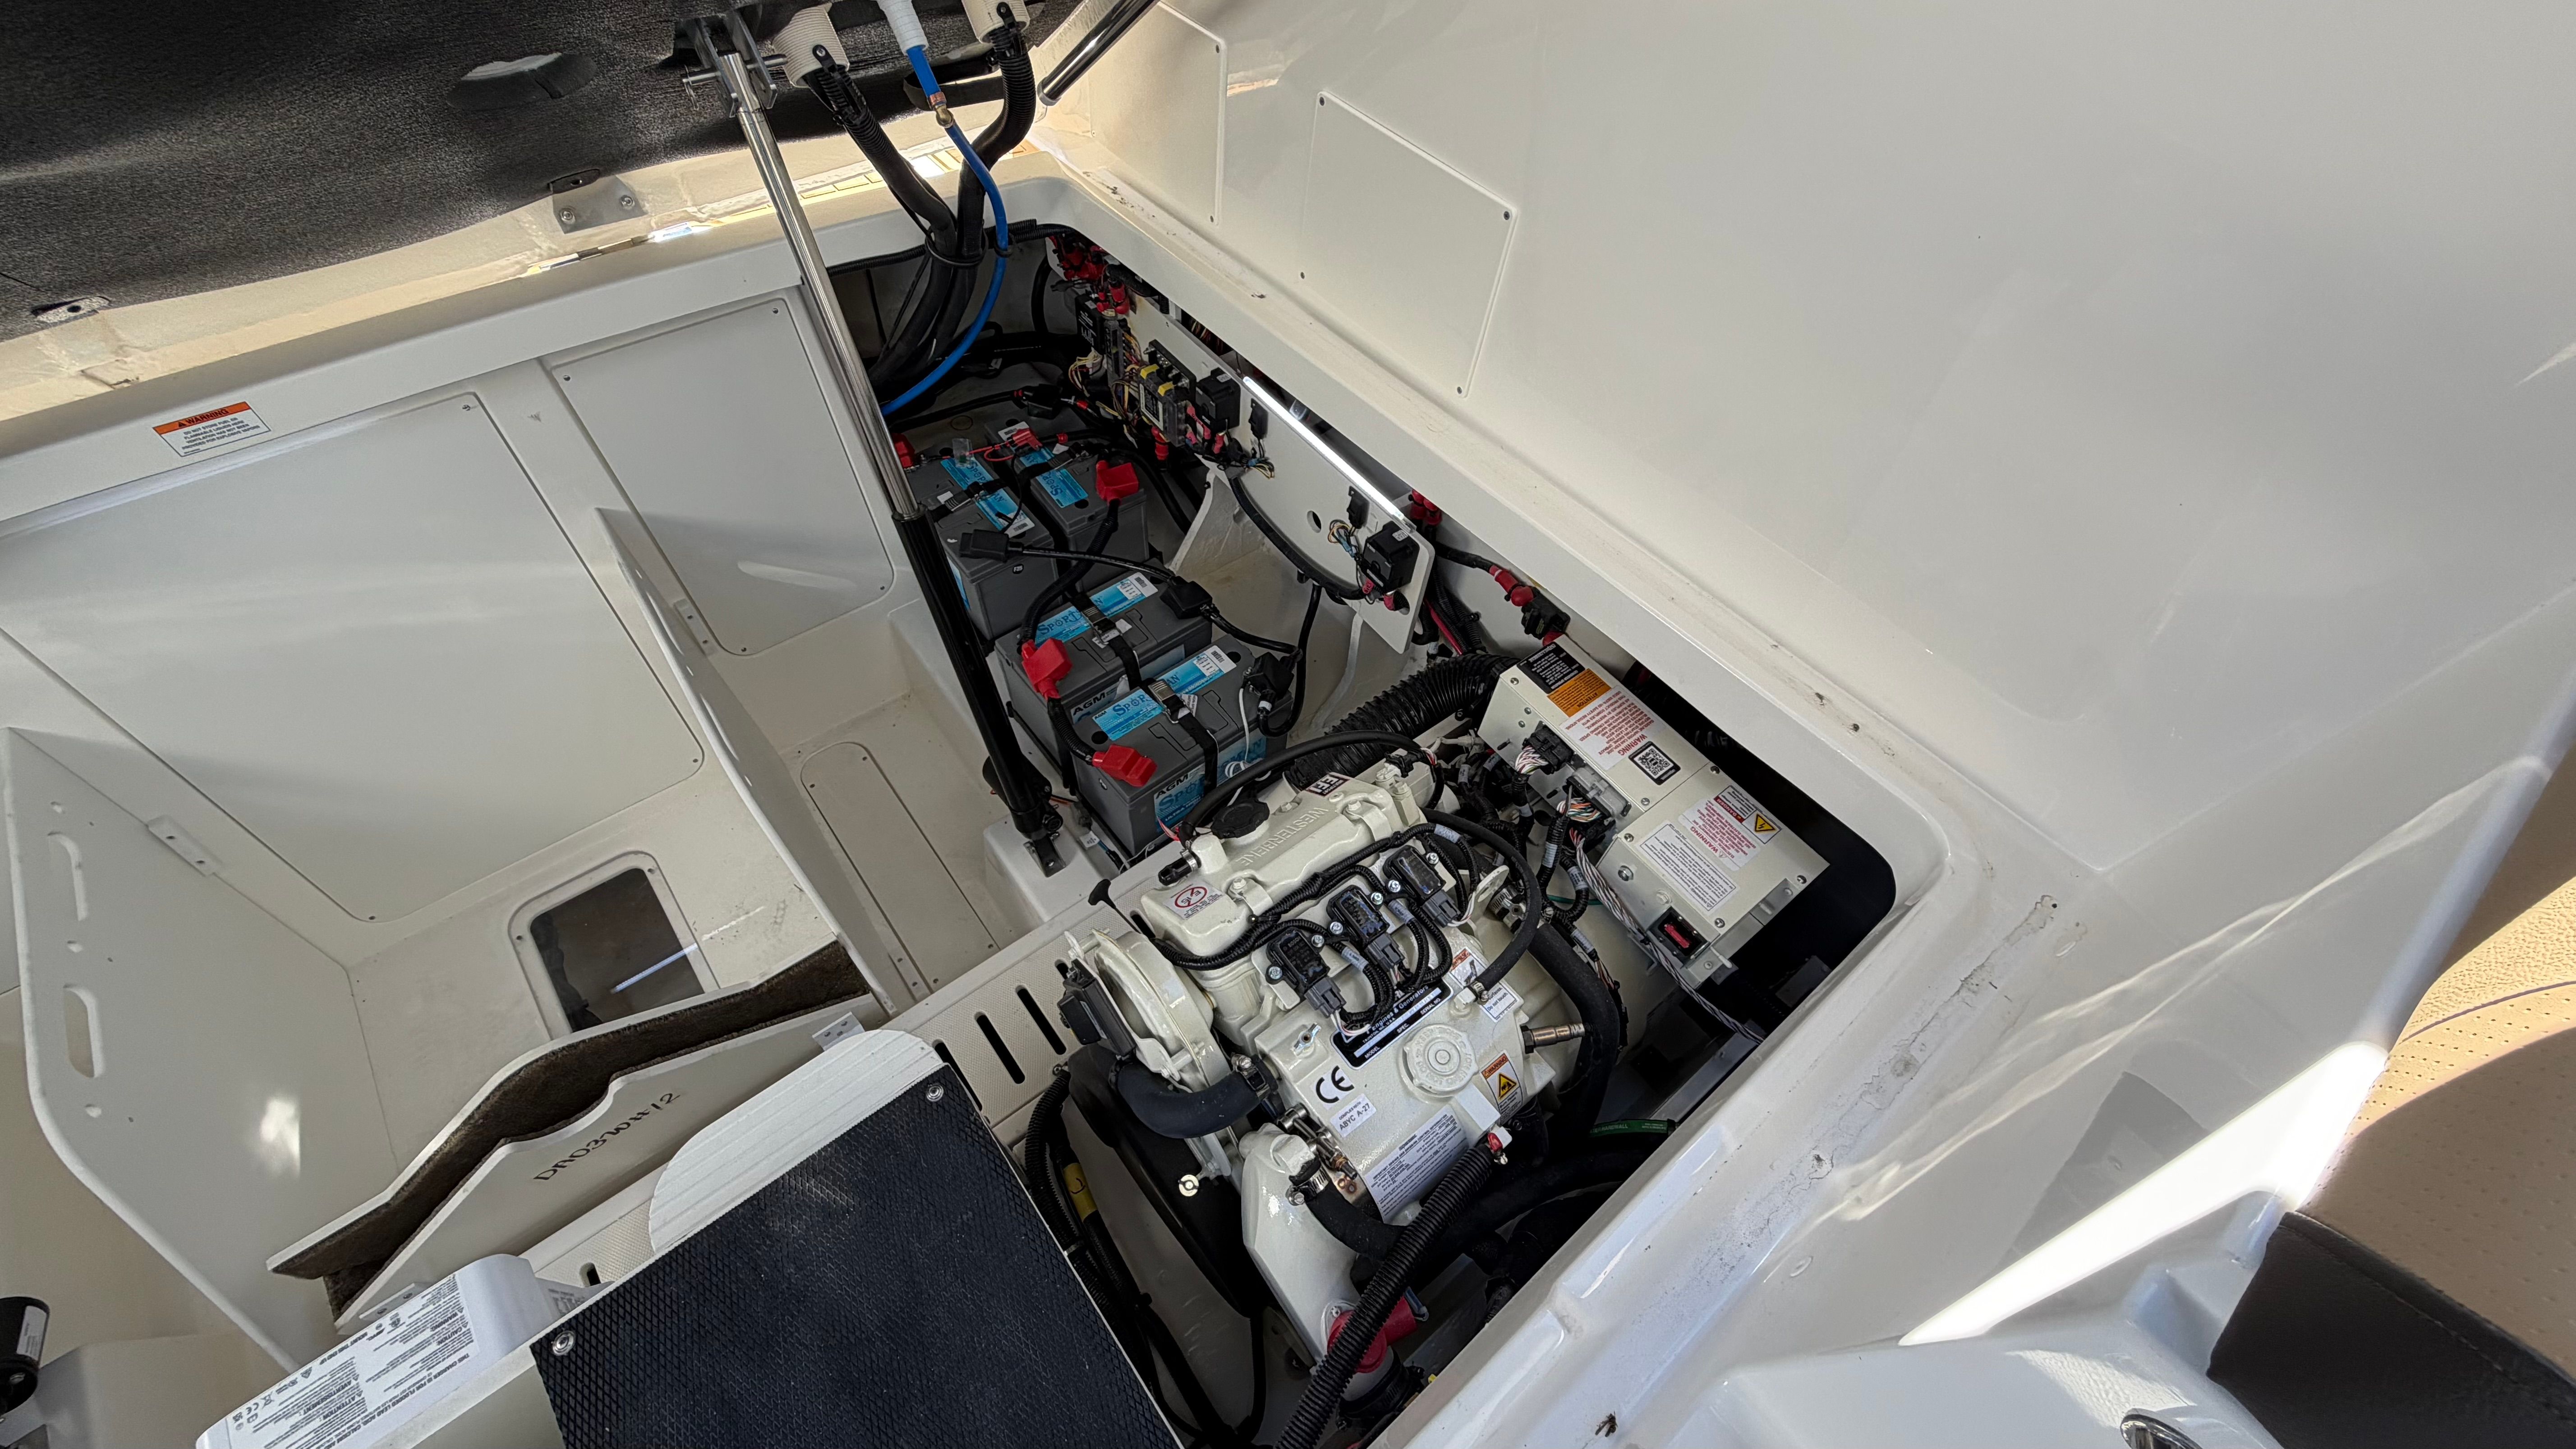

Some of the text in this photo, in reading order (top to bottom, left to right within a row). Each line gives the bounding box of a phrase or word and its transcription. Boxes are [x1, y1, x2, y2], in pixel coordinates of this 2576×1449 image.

[184, 408, 230, 425] WARNING
[1073, 692, 1105, 716] AGM
[1628, 708, 1641, 717] ENGINE
[1095, 710, 1107, 720] AGM
[1606, 715, 1631, 732] COMPARTMENT
[1633, 713, 1648, 724] BLOWER
[1637, 716, 1651, 726] BEFORE
[1613, 729, 1625, 738] LEAST
[1623, 724, 1639, 736] STARTING
[1638, 719, 1655, 731] GASOLINE
[1605, 736, 1615, 745] FOUR
[1626, 729, 1640, 740] VAPORS
[1597, 743, 1614, 755] OPERATE
[1615, 732, 1648, 756] WARNING
[1156, 772, 1189, 799] AGM
[1309, 775, 1339, 793] EFI
[1716, 798, 1738, 818] DANGER
[1235, 807, 1329, 866] WESTERBEKE
[1690, 826, 1719, 854] WARNING
[1372, 1012, 1394, 1031] Engines
[1398, 984, 1429, 1009] Generators
[1486, 1003, 1494, 1012] Do
[1365, 1045, 1380, 1059] MODEL
[1420, 1004, 1434, 1015] SERIAL
[1488, 1056, 1506, 1074] WARNING
[1316, 1065, 1355, 1104] CE
[1339, 1103, 1370, 1131] ABYC A-27
[428, 1310, 458, 1334] WARNING:
[435, 1325, 463, 1347] CAUTION:
[456, 1352, 469, 1364] THIS
[432, 1359, 457, 1380] CHARGER
[415, 1380, 427, 1392] FOR
[426, 1376, 432, 1384] IS
[302, 1379, 352, 1416] AVERTISSEMENT
[391, 1387, 415, 1408] FLOODED
[322, 1394, 356, 1421] ATTENTION
[376, 1403, 391, 1417] LEAD
